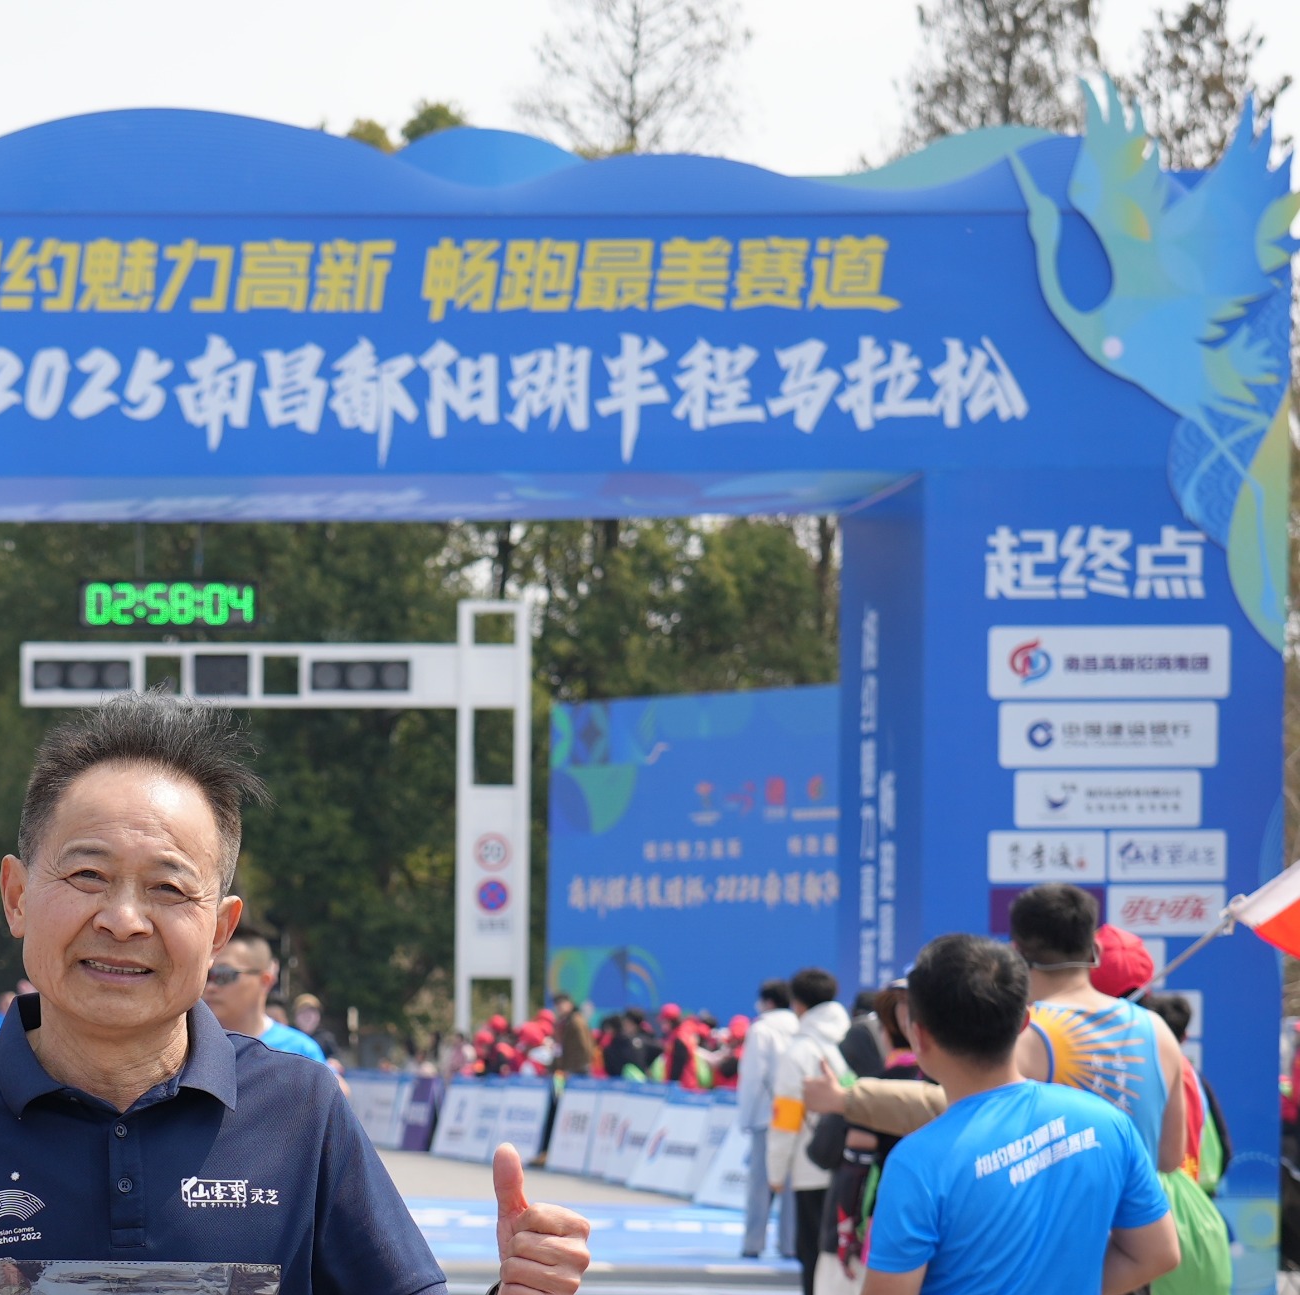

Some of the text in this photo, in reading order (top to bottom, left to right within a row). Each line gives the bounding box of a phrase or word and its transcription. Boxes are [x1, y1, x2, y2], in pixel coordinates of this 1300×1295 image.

[421, 235, 902, 322] 畅跑最美赛道
[984, 525, 1207, 599] 起终点
[86, 582, 254, 626] 02:58:04
[13, 1226, 34, 1234] Games
[21, 1232, 42, 1241] 2022
